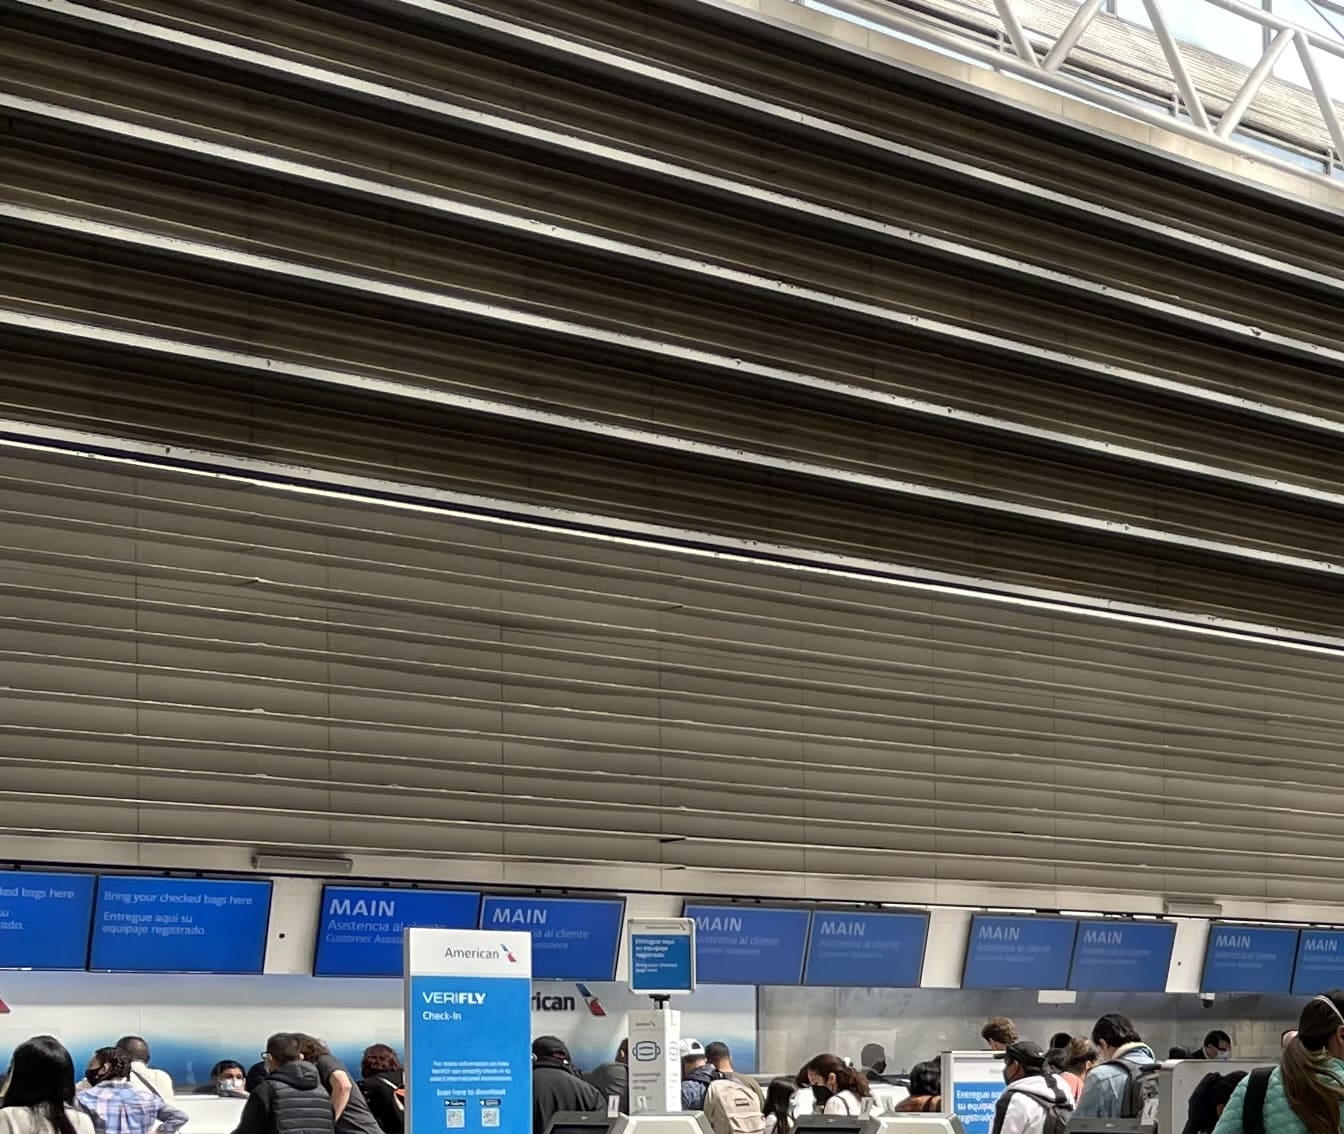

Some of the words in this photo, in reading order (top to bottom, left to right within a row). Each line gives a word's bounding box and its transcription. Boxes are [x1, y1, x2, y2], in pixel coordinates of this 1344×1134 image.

[160, 893, 201, 904] checked
[204, 894, 227, 906] bags
[329, 899, 395, 916] MAIN
[104, 912, 152, 924] Entregue
[181, 915, 192, 923] su
[492, 908, 547, 924] MAIN
[102, 924, 149, 936] equipaje
[328, 920, 390, 932] Asistencia
[696, 917, 742, 932] MAIN
[820, 920, 866, 936] MAIN
[978, 926, 1020, 940] MAIN
[1083, 930, 1122, 944] MAIN
[1216, 936, 1251, 948] MAIN
[1304, 939, 1338, 952] MAIN
[444, 948, 500, 960] American
[422, 992, 486, 1004] VERIFLY
[532, 992, 575, 1011] rican
[422, 1010, 462, 1021] Check-In
